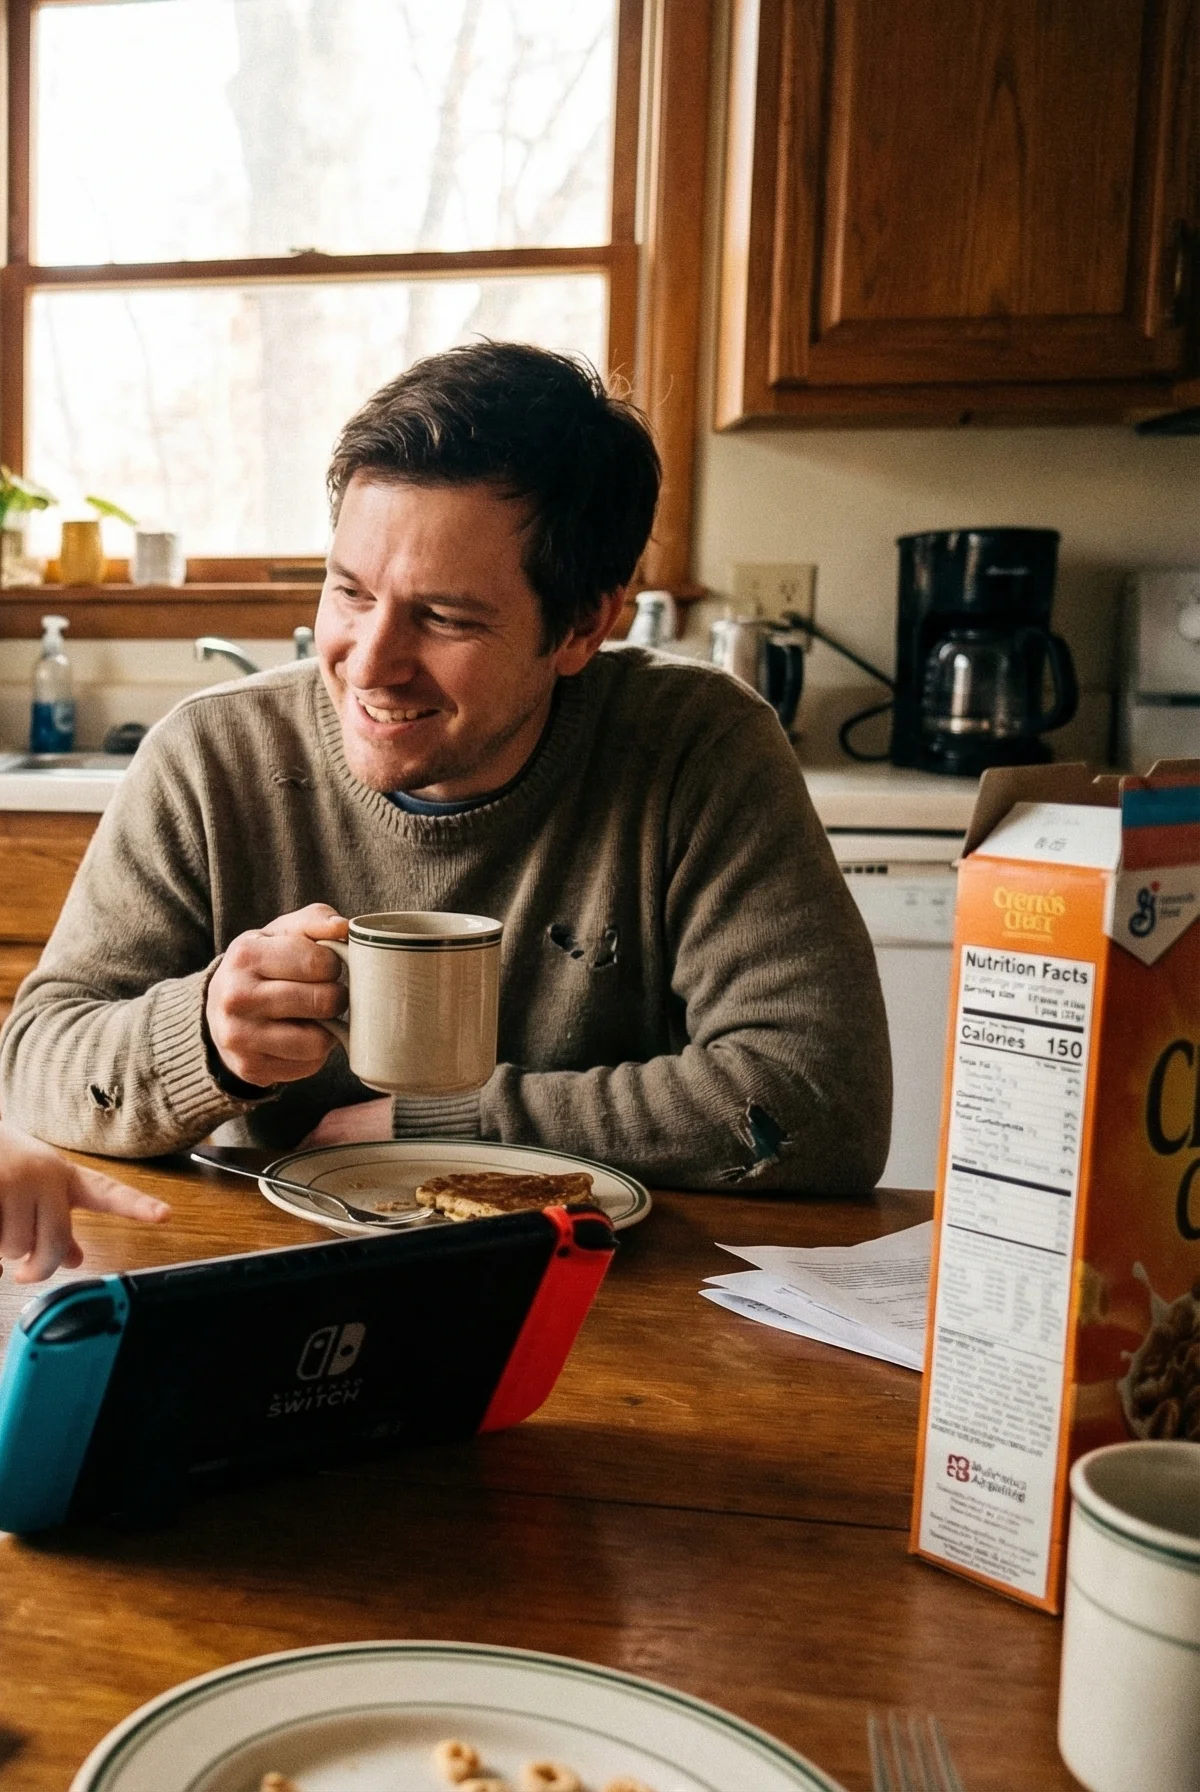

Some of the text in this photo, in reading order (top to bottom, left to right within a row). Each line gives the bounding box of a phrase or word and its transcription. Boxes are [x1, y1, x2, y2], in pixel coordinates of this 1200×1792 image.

[966, 951, 1036, 978] Nutrition
[1042, 962, 1088, 985] Facts
[961, 1024, 1026, 1050] Calories
[1047, 1036, 1083, 1059] 150
[266, 1387, 361, 1418] SWITCH
